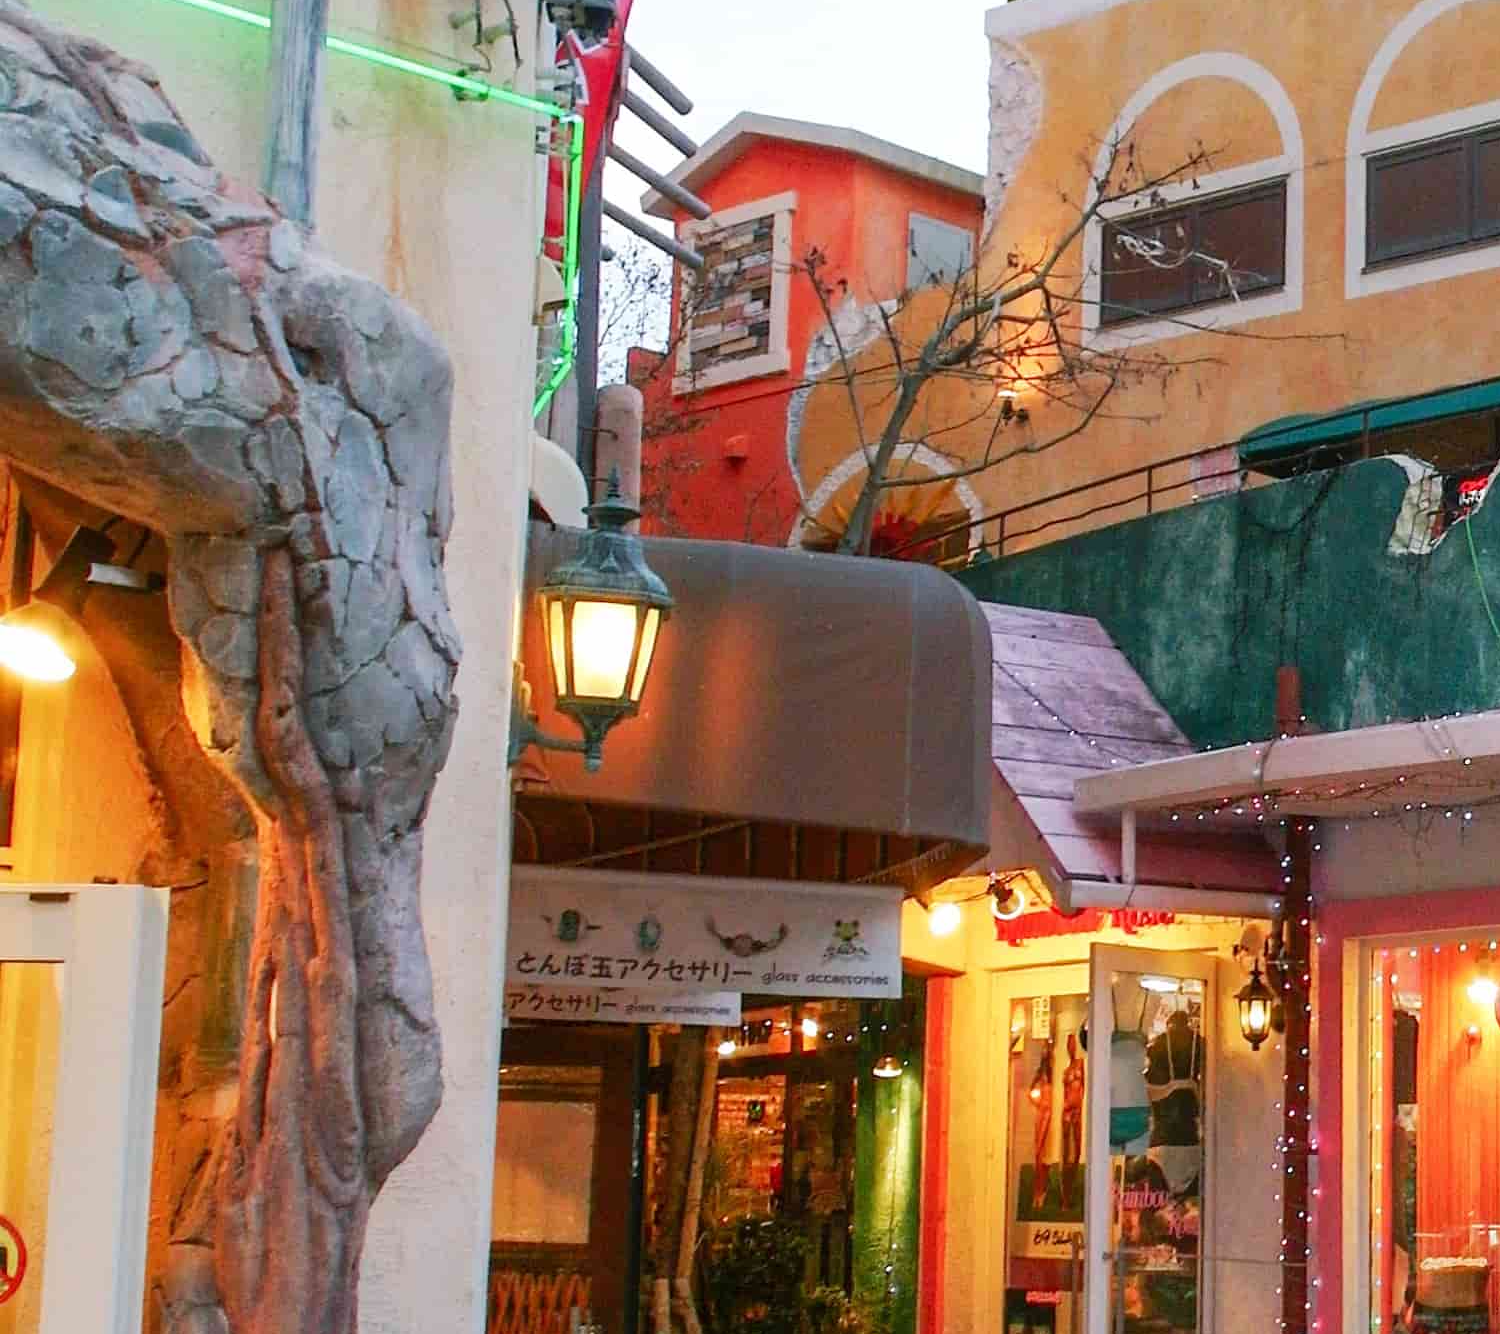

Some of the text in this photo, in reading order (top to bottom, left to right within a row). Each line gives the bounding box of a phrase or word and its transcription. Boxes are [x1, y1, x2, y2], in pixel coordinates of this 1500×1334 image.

[516, 951, 753, 984] とんぼ玉アクセサリー
[760, 962, 799, 986] glass
